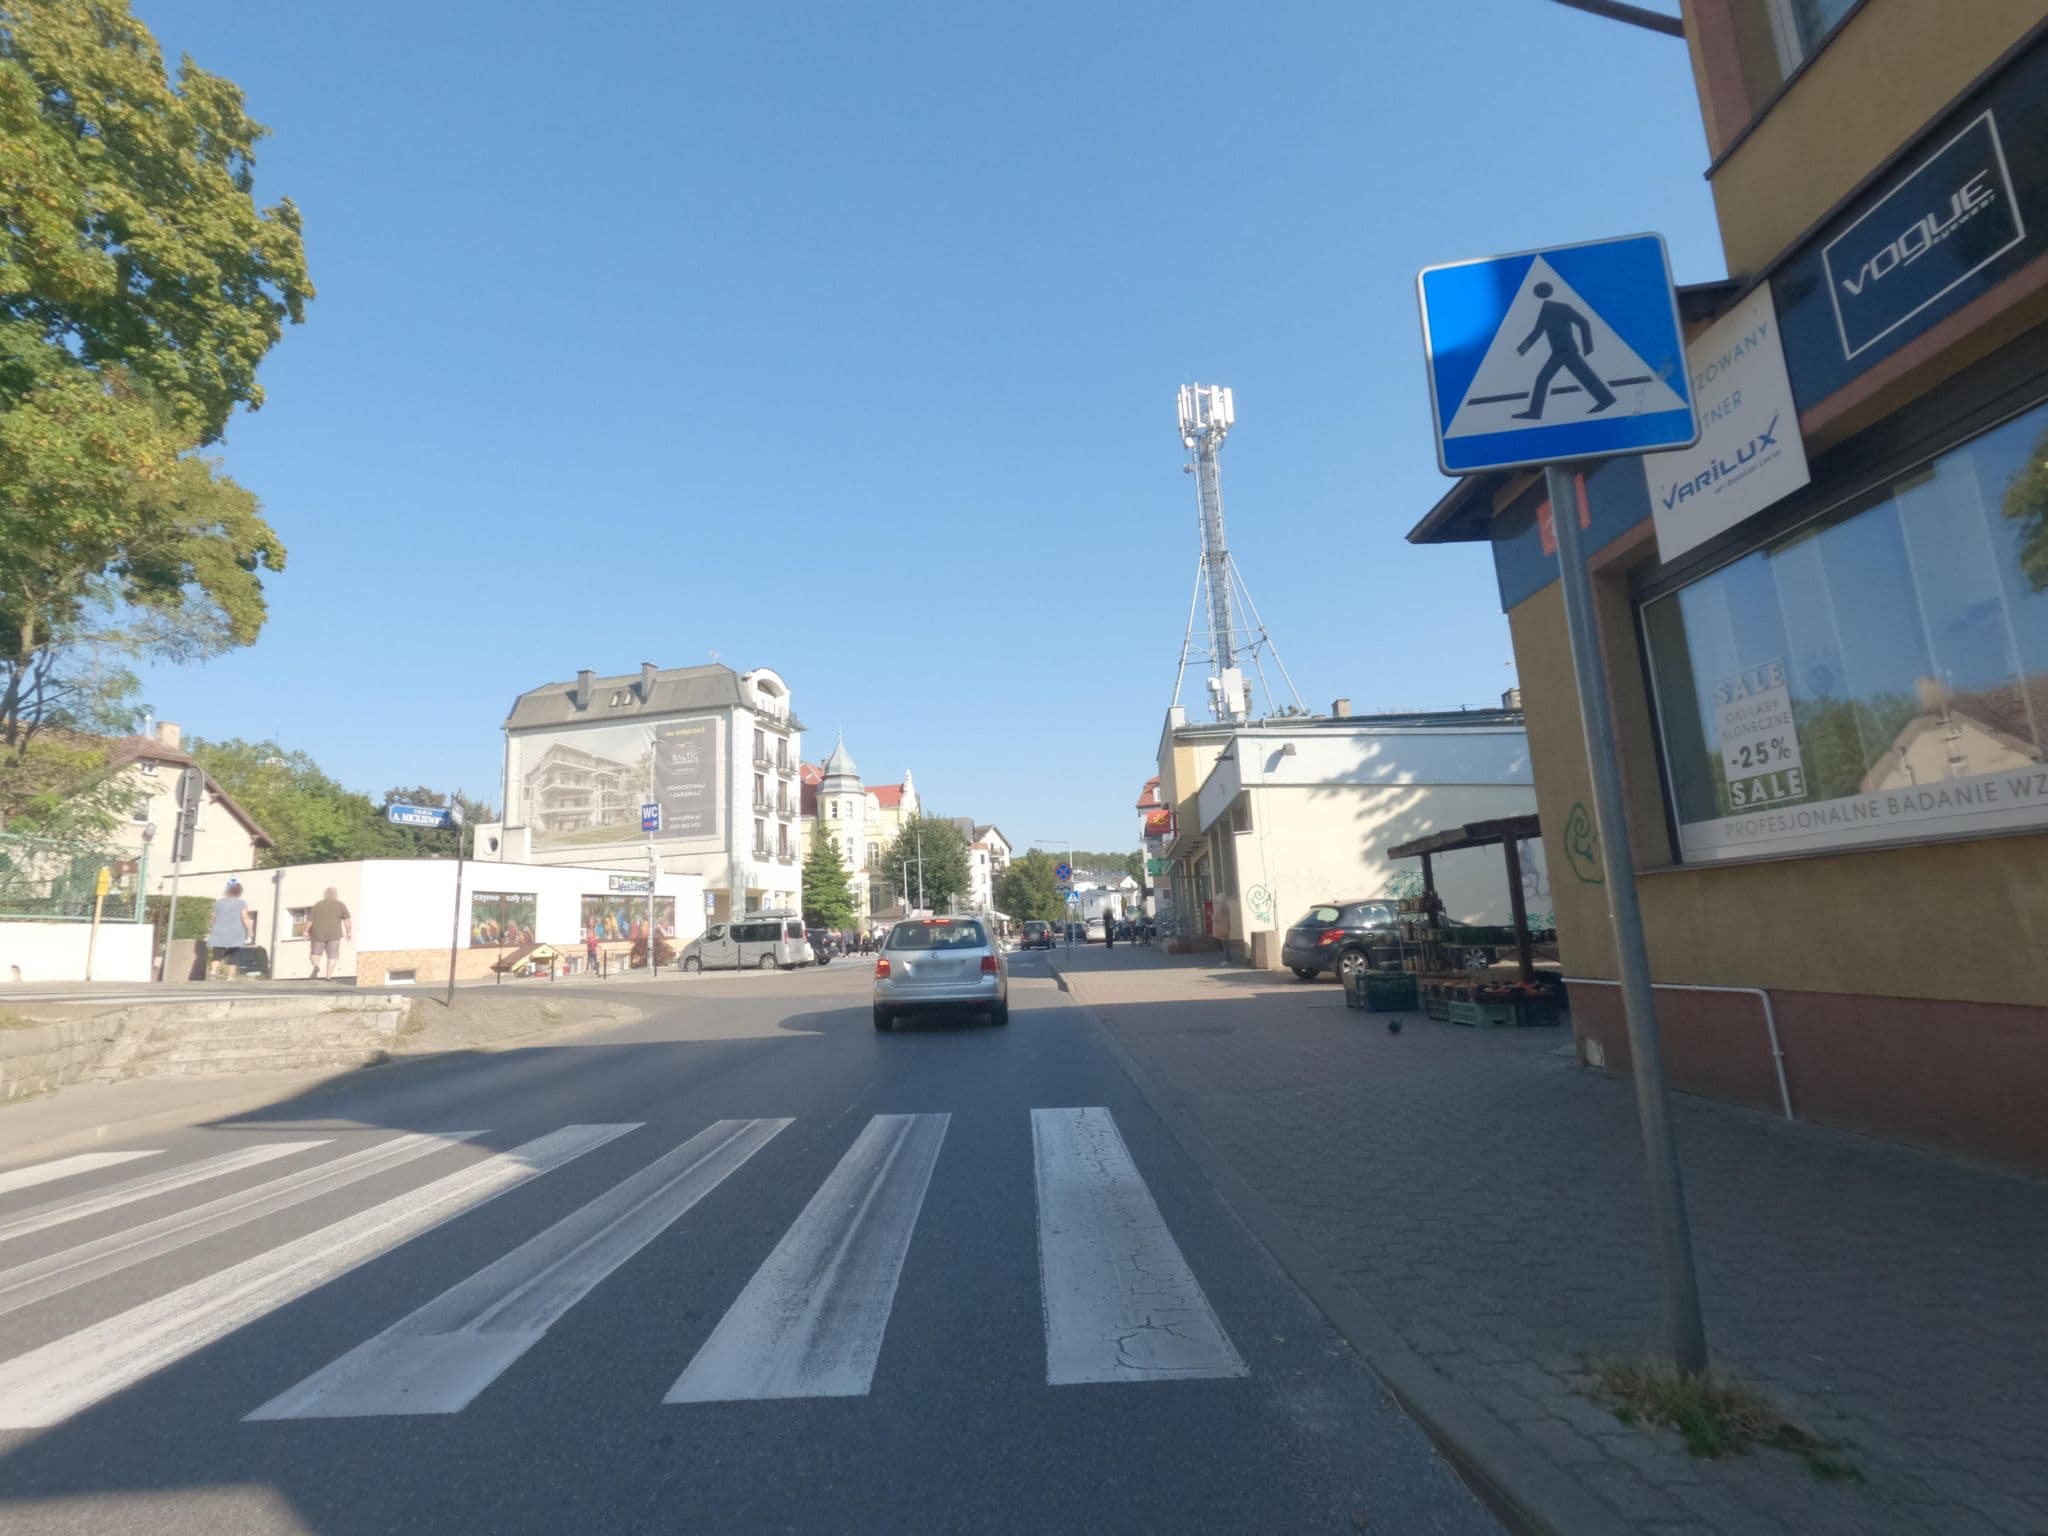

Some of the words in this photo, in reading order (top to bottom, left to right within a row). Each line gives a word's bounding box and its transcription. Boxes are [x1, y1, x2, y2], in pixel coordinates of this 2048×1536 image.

[1842, 168, 1994, 296] VOGUE
[1662, 413, 1780, 511] VARILUX
[1714, 663, 1785, 704] SALE
[1731, 736, 1792, 769] -25%
[1732, 768, 1803, 806] SALE
[642, 806, 658, 819] WC
[1726, 799, 1880, 839] PROFESJONALNE
[1888, 781, 1999, 816] BADANIE
